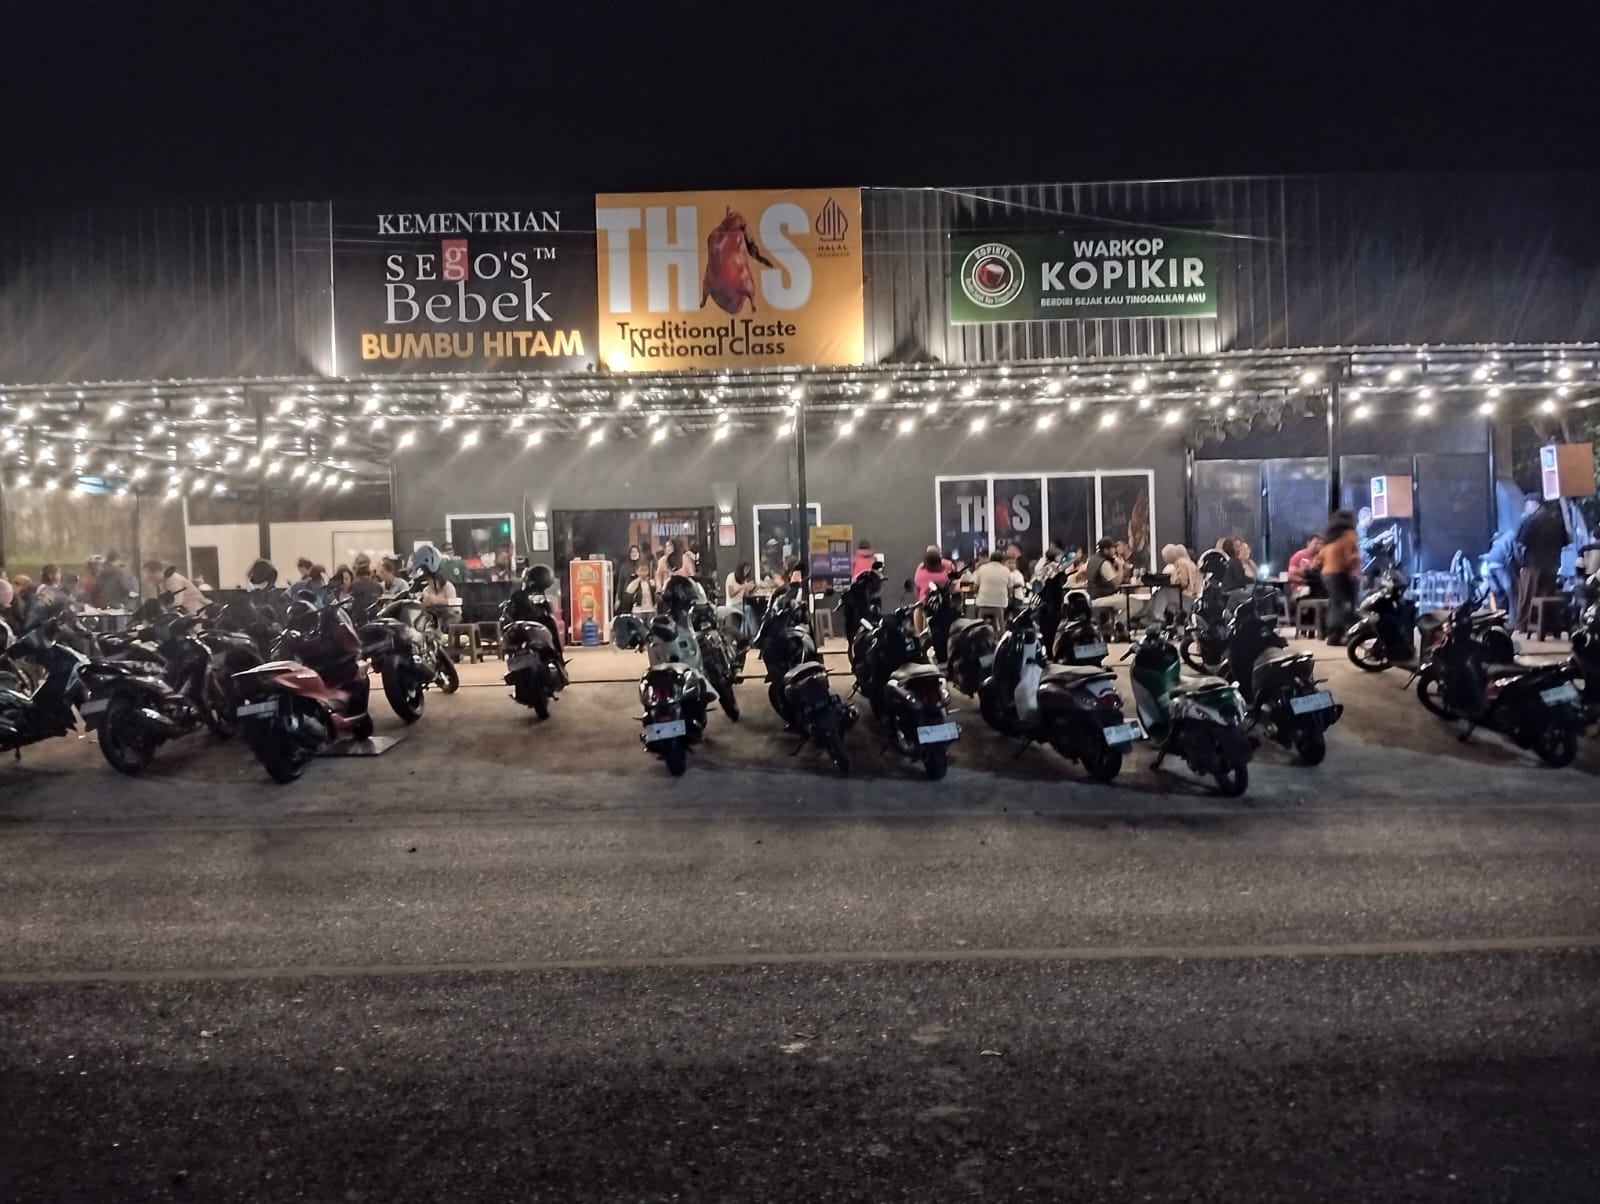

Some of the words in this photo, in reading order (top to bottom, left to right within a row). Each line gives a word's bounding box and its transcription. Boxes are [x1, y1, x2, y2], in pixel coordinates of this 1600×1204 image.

[377, 211, 561, 234] KEMENTRIAN
[1073, 238, 1164, 258] WARKOP
[1041, 257, 1206, 291] KOPIKIR
[384, 278, 554, 325] Bebek
[1040, 297, 1073, 307] BERDIRI
[1074, 296, 1102, 306] SEJAK
[1104, 295, 1124, 305] KAU
[1125, 293, 1185, 305] TINGGALKAN
[617, 319, 736, 341] Traditional
[741, 319, 797, 339] Taste
[361, 332, 474, 360] BUMBU
[483, 330, 586, 358] HITAM
[630, 336, 723, 358] National
[728, 336, 785, 356] Class
